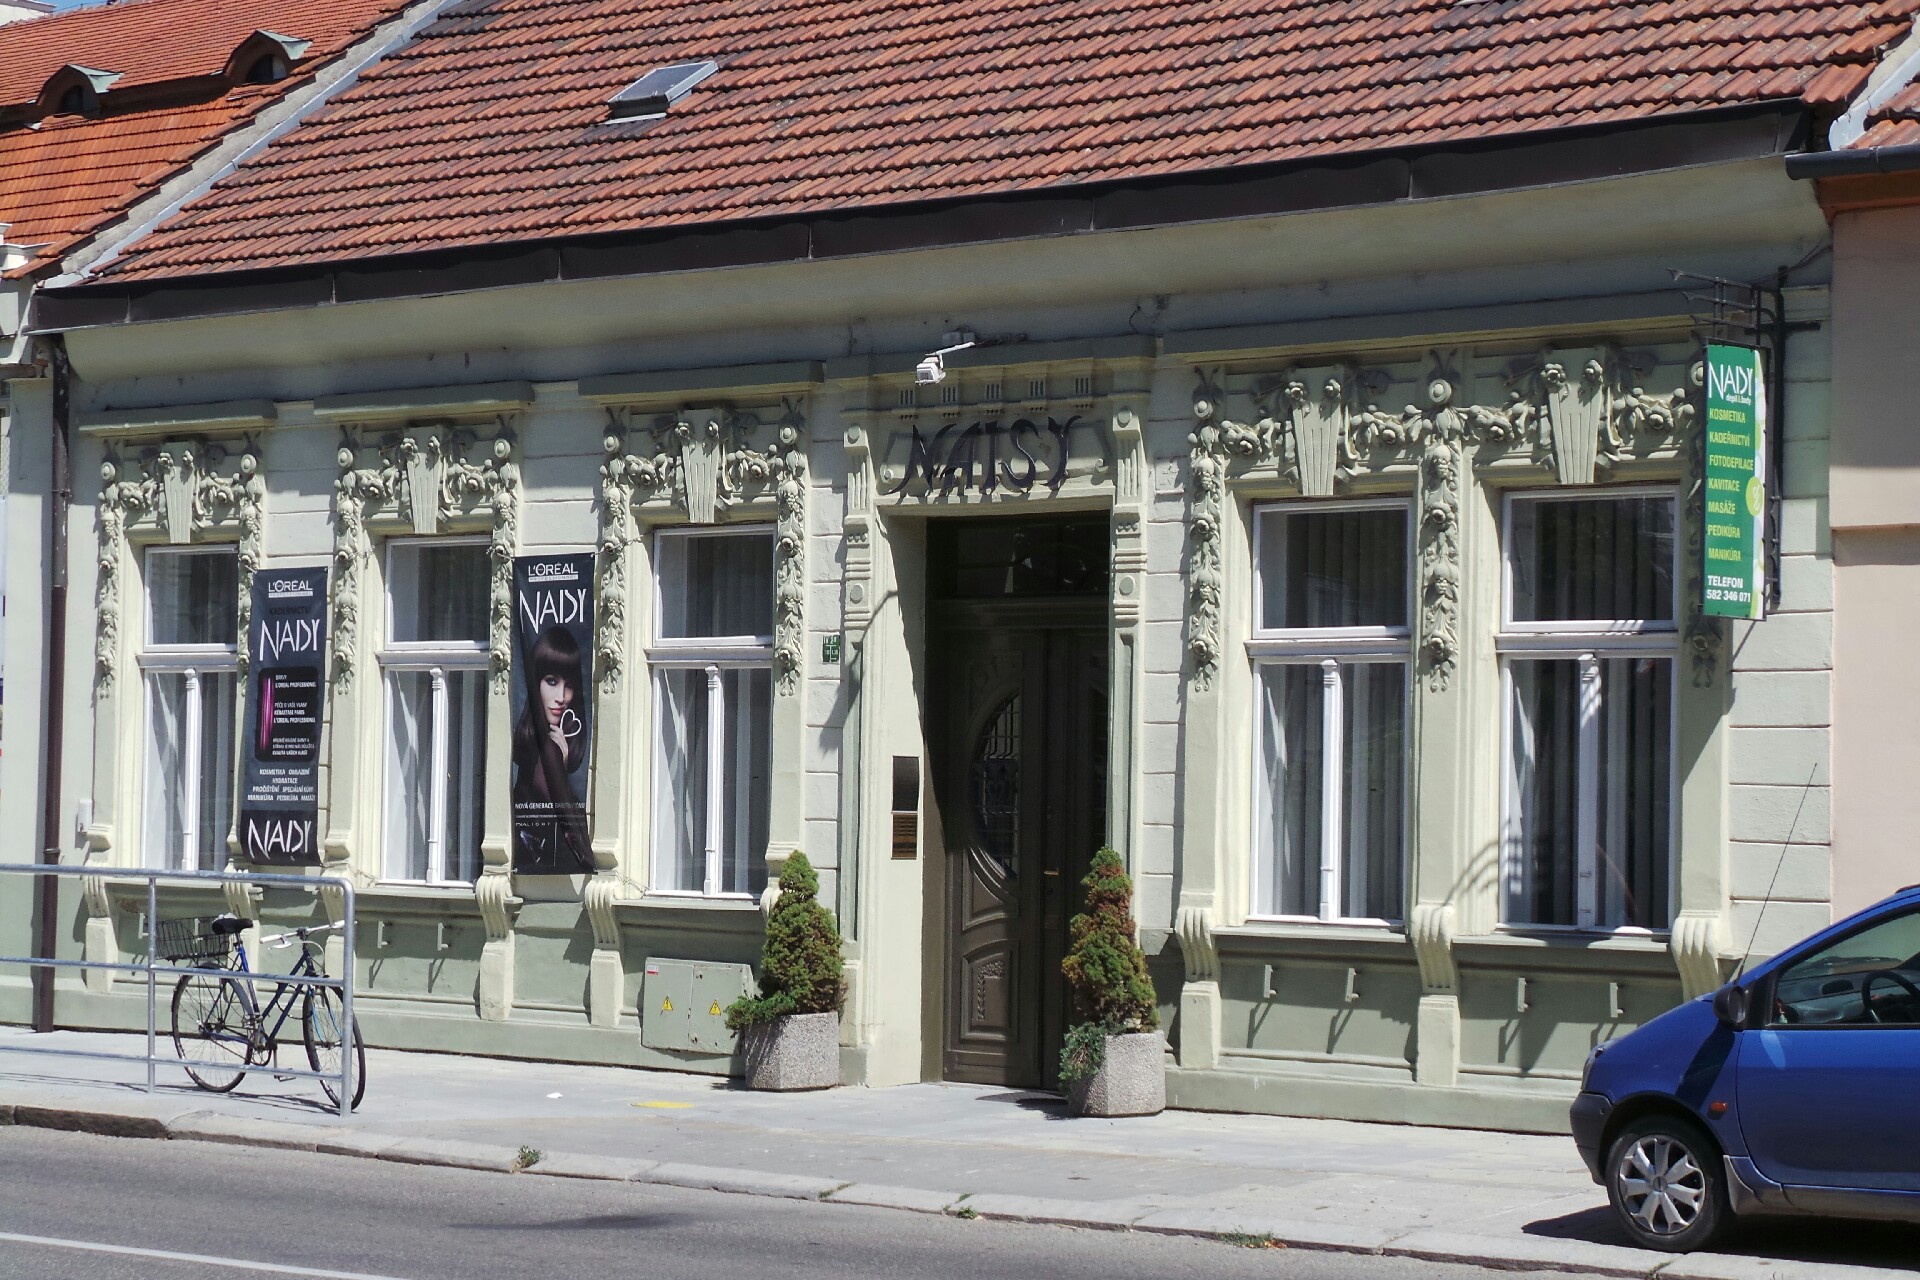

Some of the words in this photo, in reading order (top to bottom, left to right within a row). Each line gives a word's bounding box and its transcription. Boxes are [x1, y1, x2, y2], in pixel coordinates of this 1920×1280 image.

[1709, 361, 1753, 400] NADY
[1709, 407, 1746, 423] KOSMETIKA
[1709, 430, 1750, 446] KADEŘNICTVÍ
[1709, 454, 1754, 470] FOTODEPILACE
[1708, 478, 1740, 491] KAVITACE
[1708, 499, 1736, 514] MASÁŽE
[1708, 524, 1741, 538] PEDIKÚRA
[1708, 547, 1742, 561] MANIKÚRA
[1707, 575, 1744, 588] TELEFON
[1706, 589, 1722, 600] 582
[1723, 590, 1738, 601] 346
[1738, 591, 1751, 602] 071
[519, 588, 587, 634] NADY
[259, 619, 320, 661] NADY
[247, 818, 312, 859] NADY
